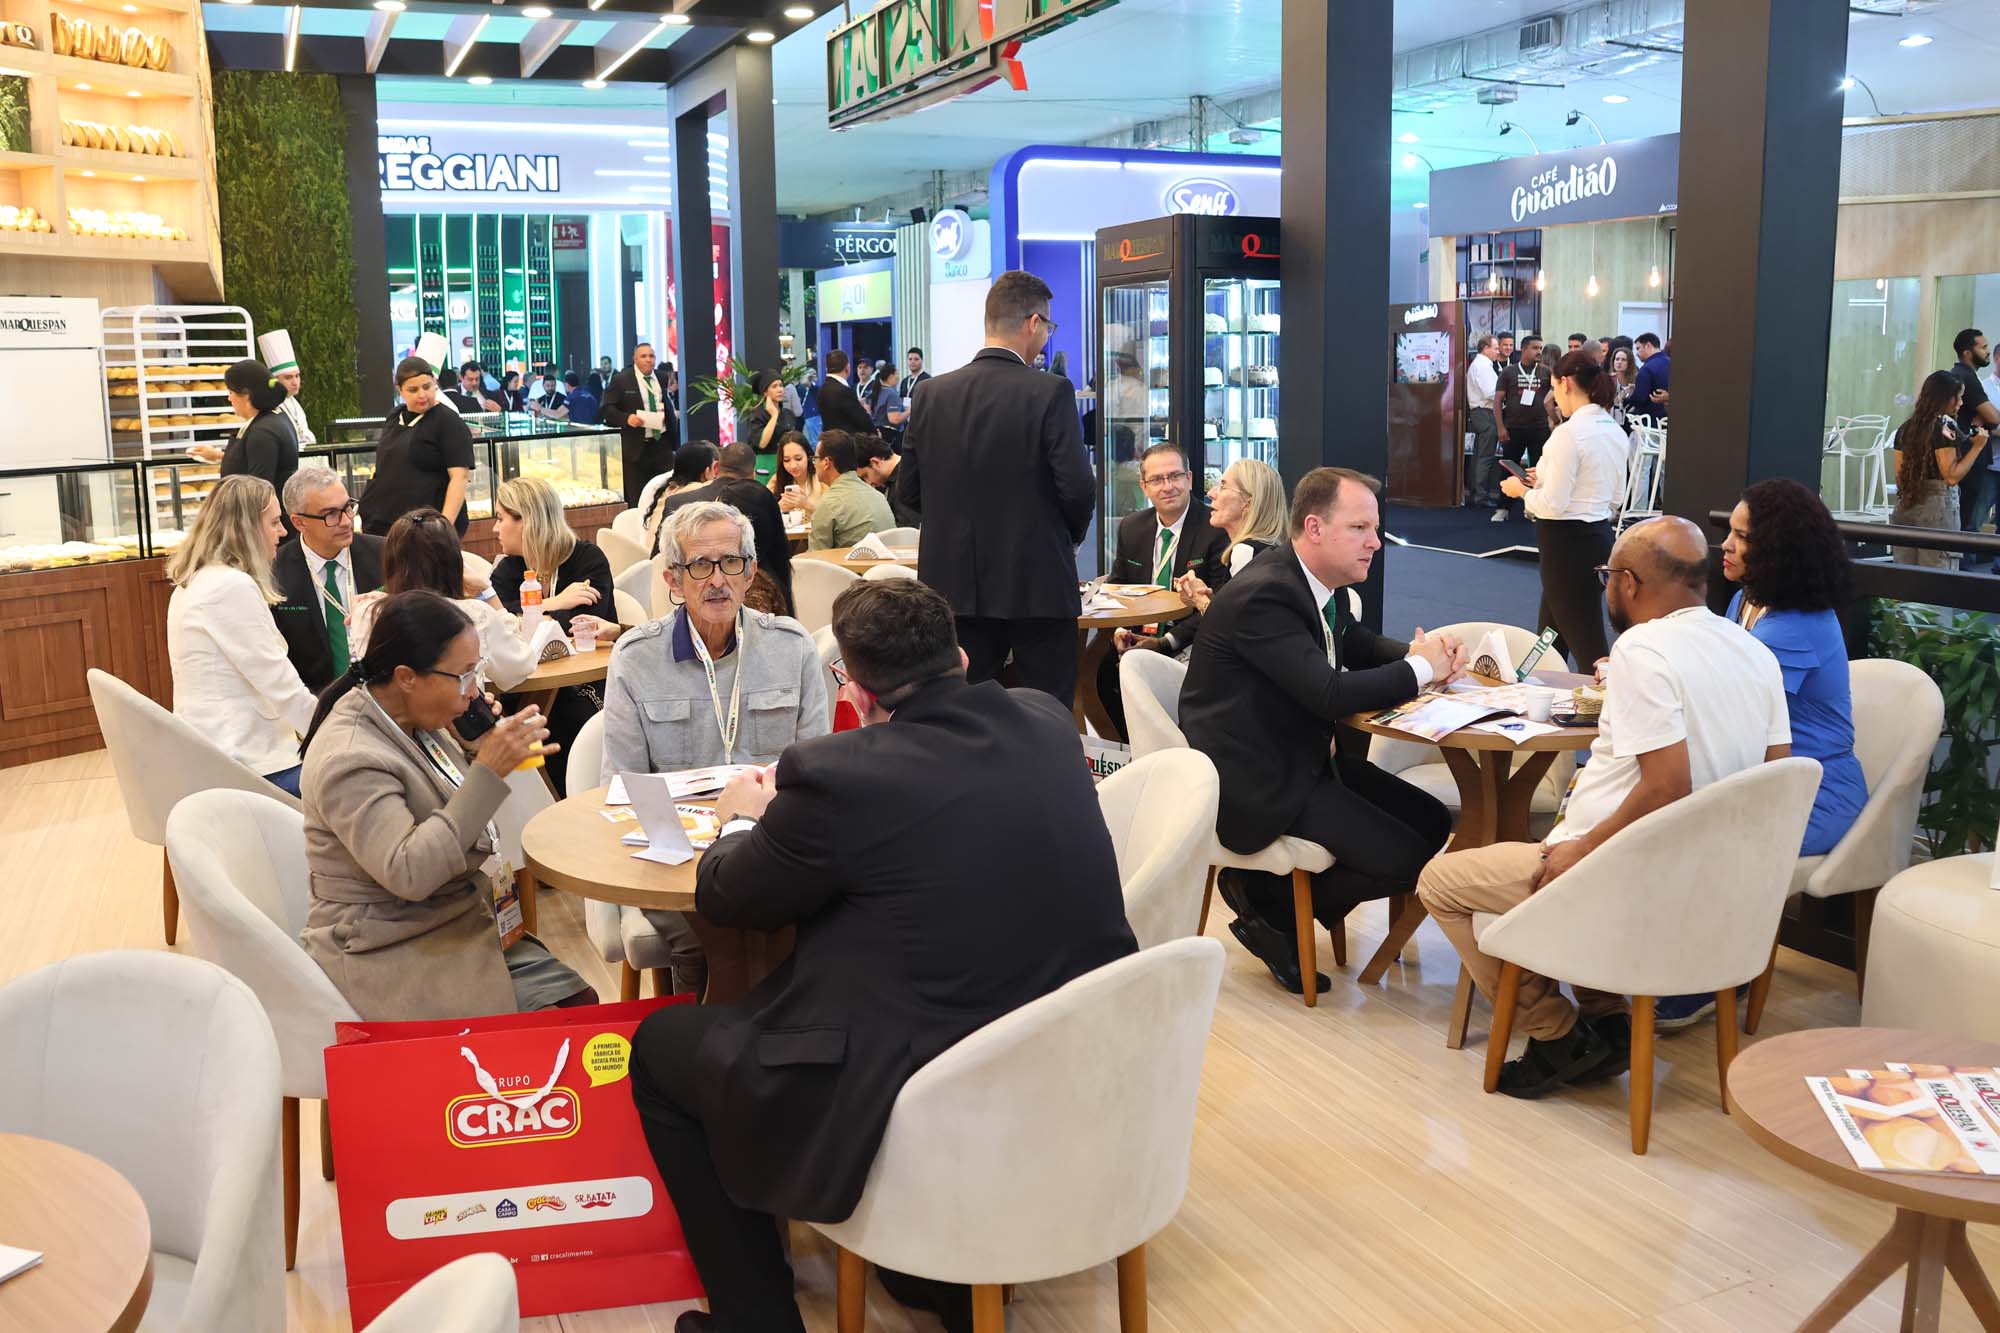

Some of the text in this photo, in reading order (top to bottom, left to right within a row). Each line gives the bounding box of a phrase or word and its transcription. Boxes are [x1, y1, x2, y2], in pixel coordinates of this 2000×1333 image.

[1531, 165, 1558, 188] CAFÉ
[1086, 756, 1126, 777] UESP
[493, 1075, 530, 1088] RUPO
[457, 1097, 571, 1137] CRAC
[550, 1249, 593, 1260] cracalimentos
